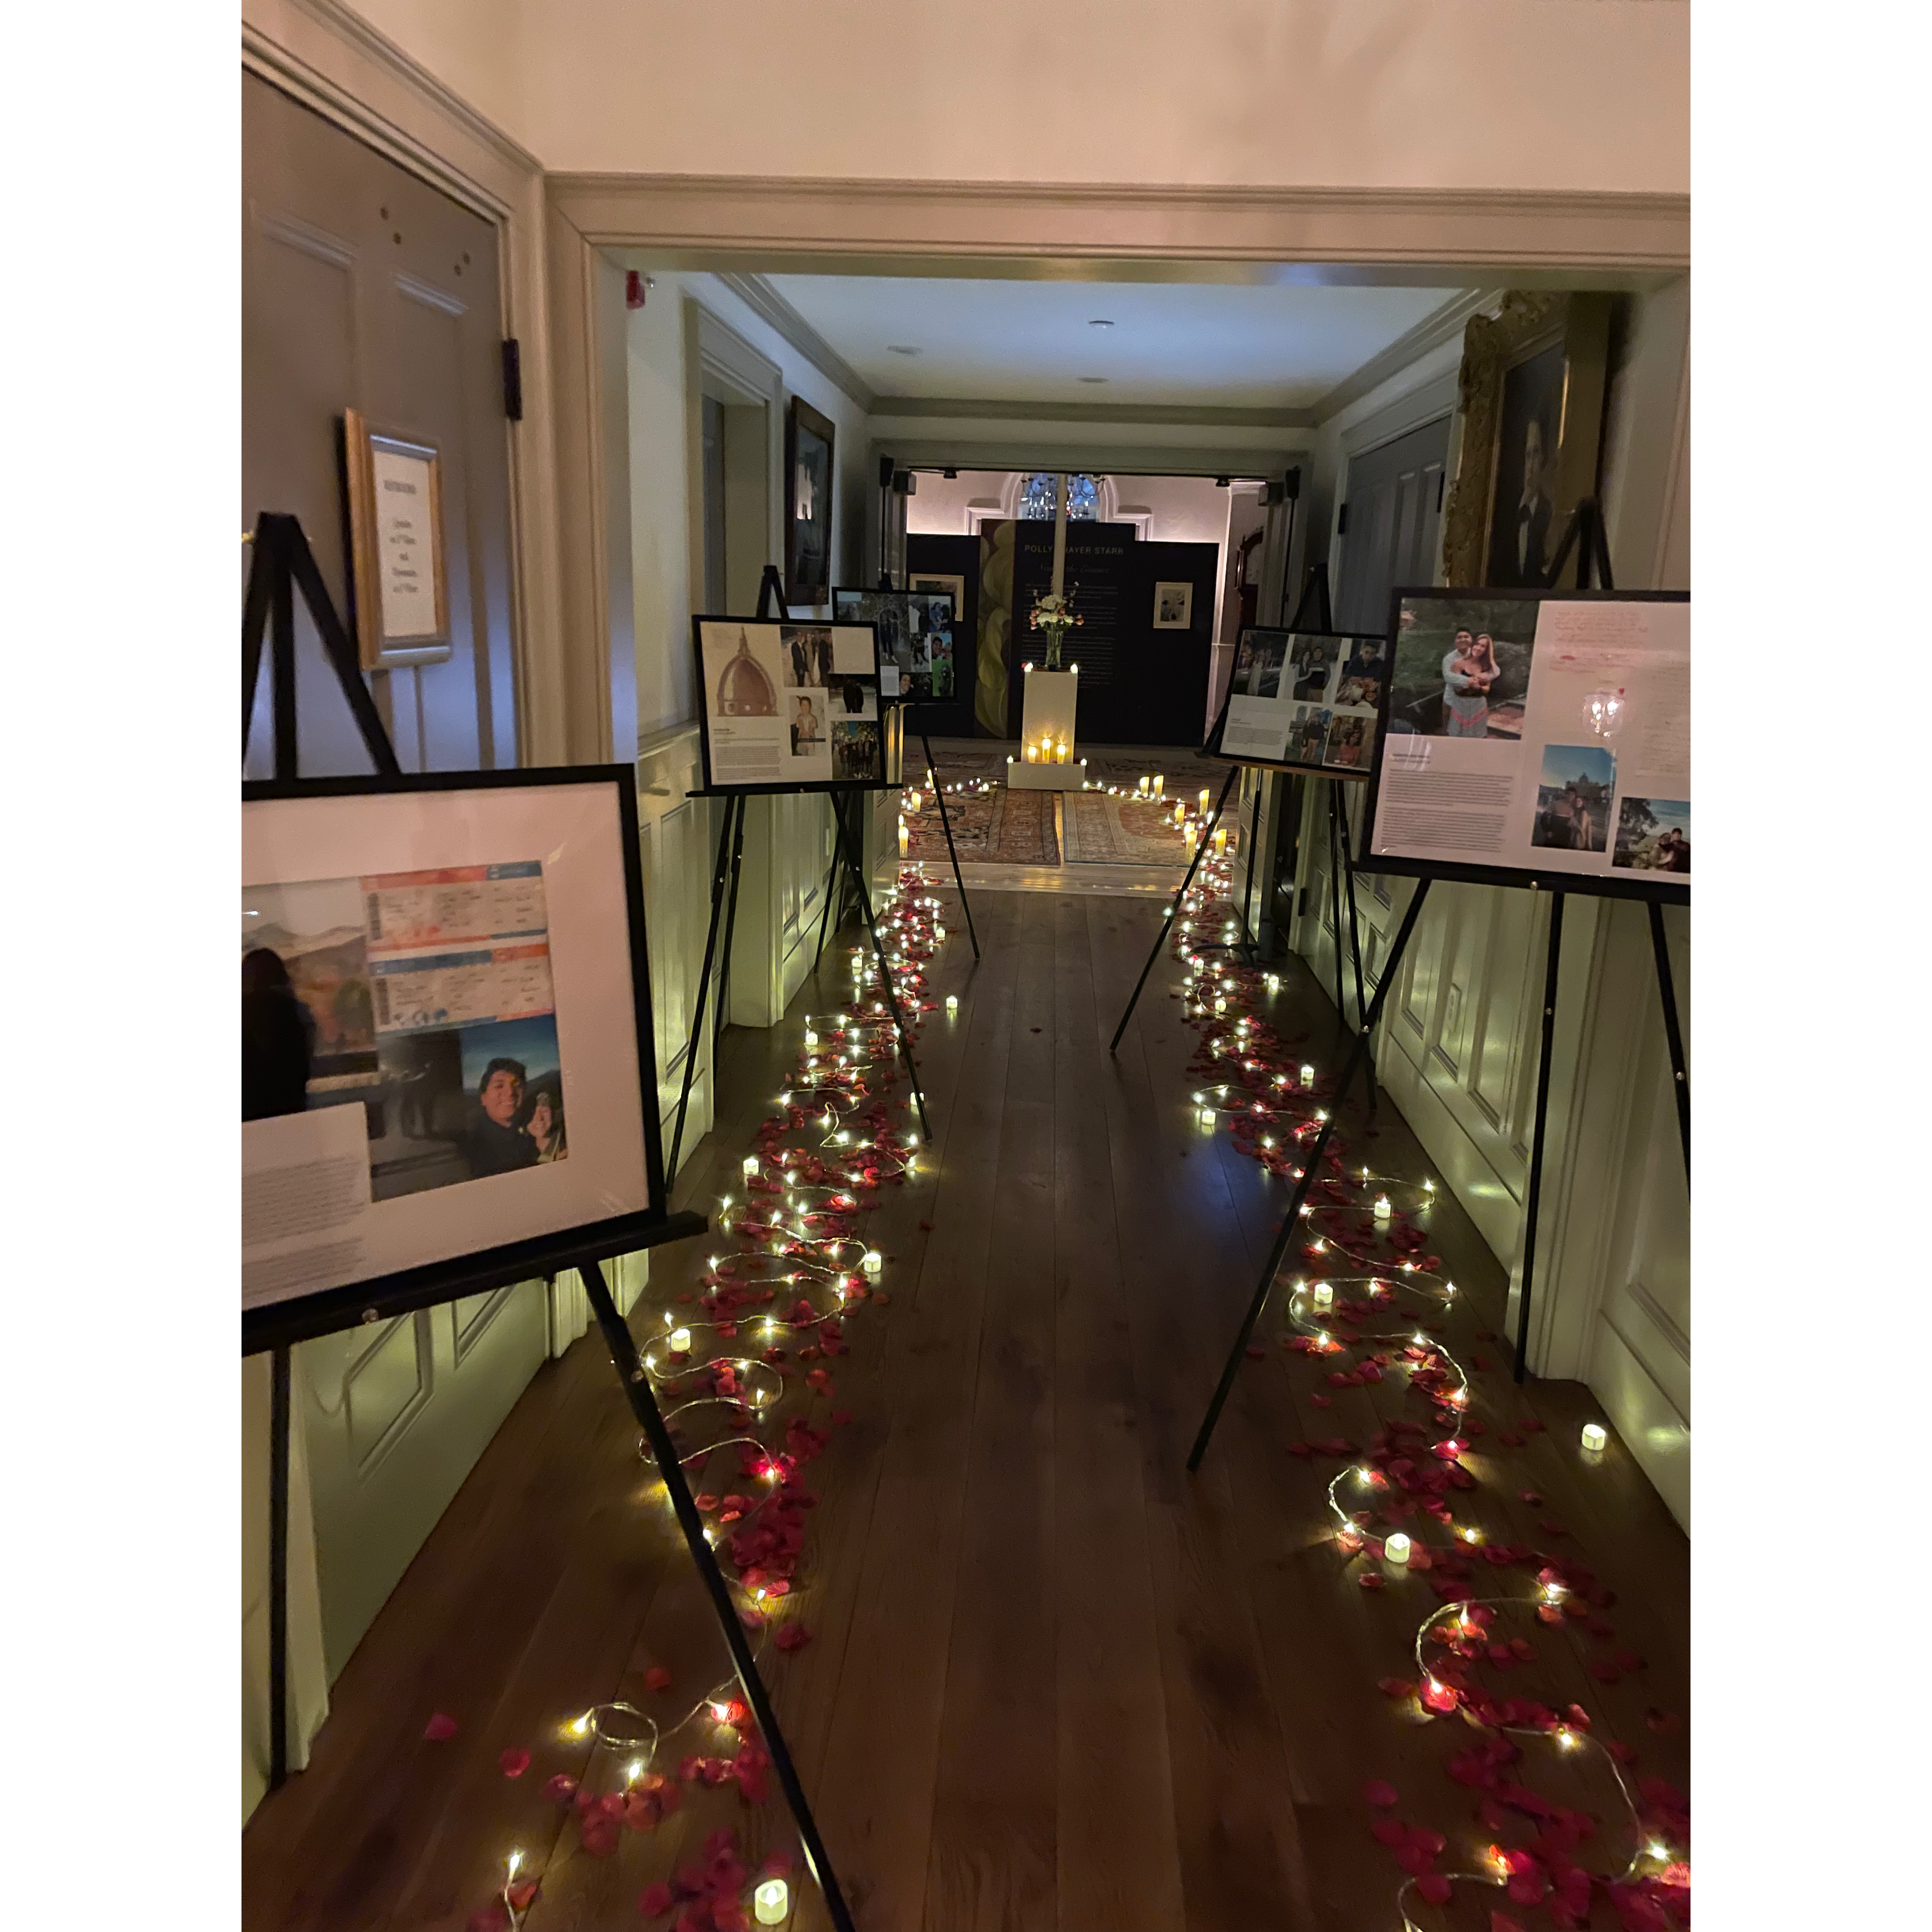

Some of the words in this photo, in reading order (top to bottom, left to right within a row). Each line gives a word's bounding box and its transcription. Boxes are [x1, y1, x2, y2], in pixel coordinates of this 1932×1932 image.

[1024, 545, 1053, 553] POLLY
[1066, 546, 1091, 554] AYER
[1094, 547, 1124, 555] STARR
